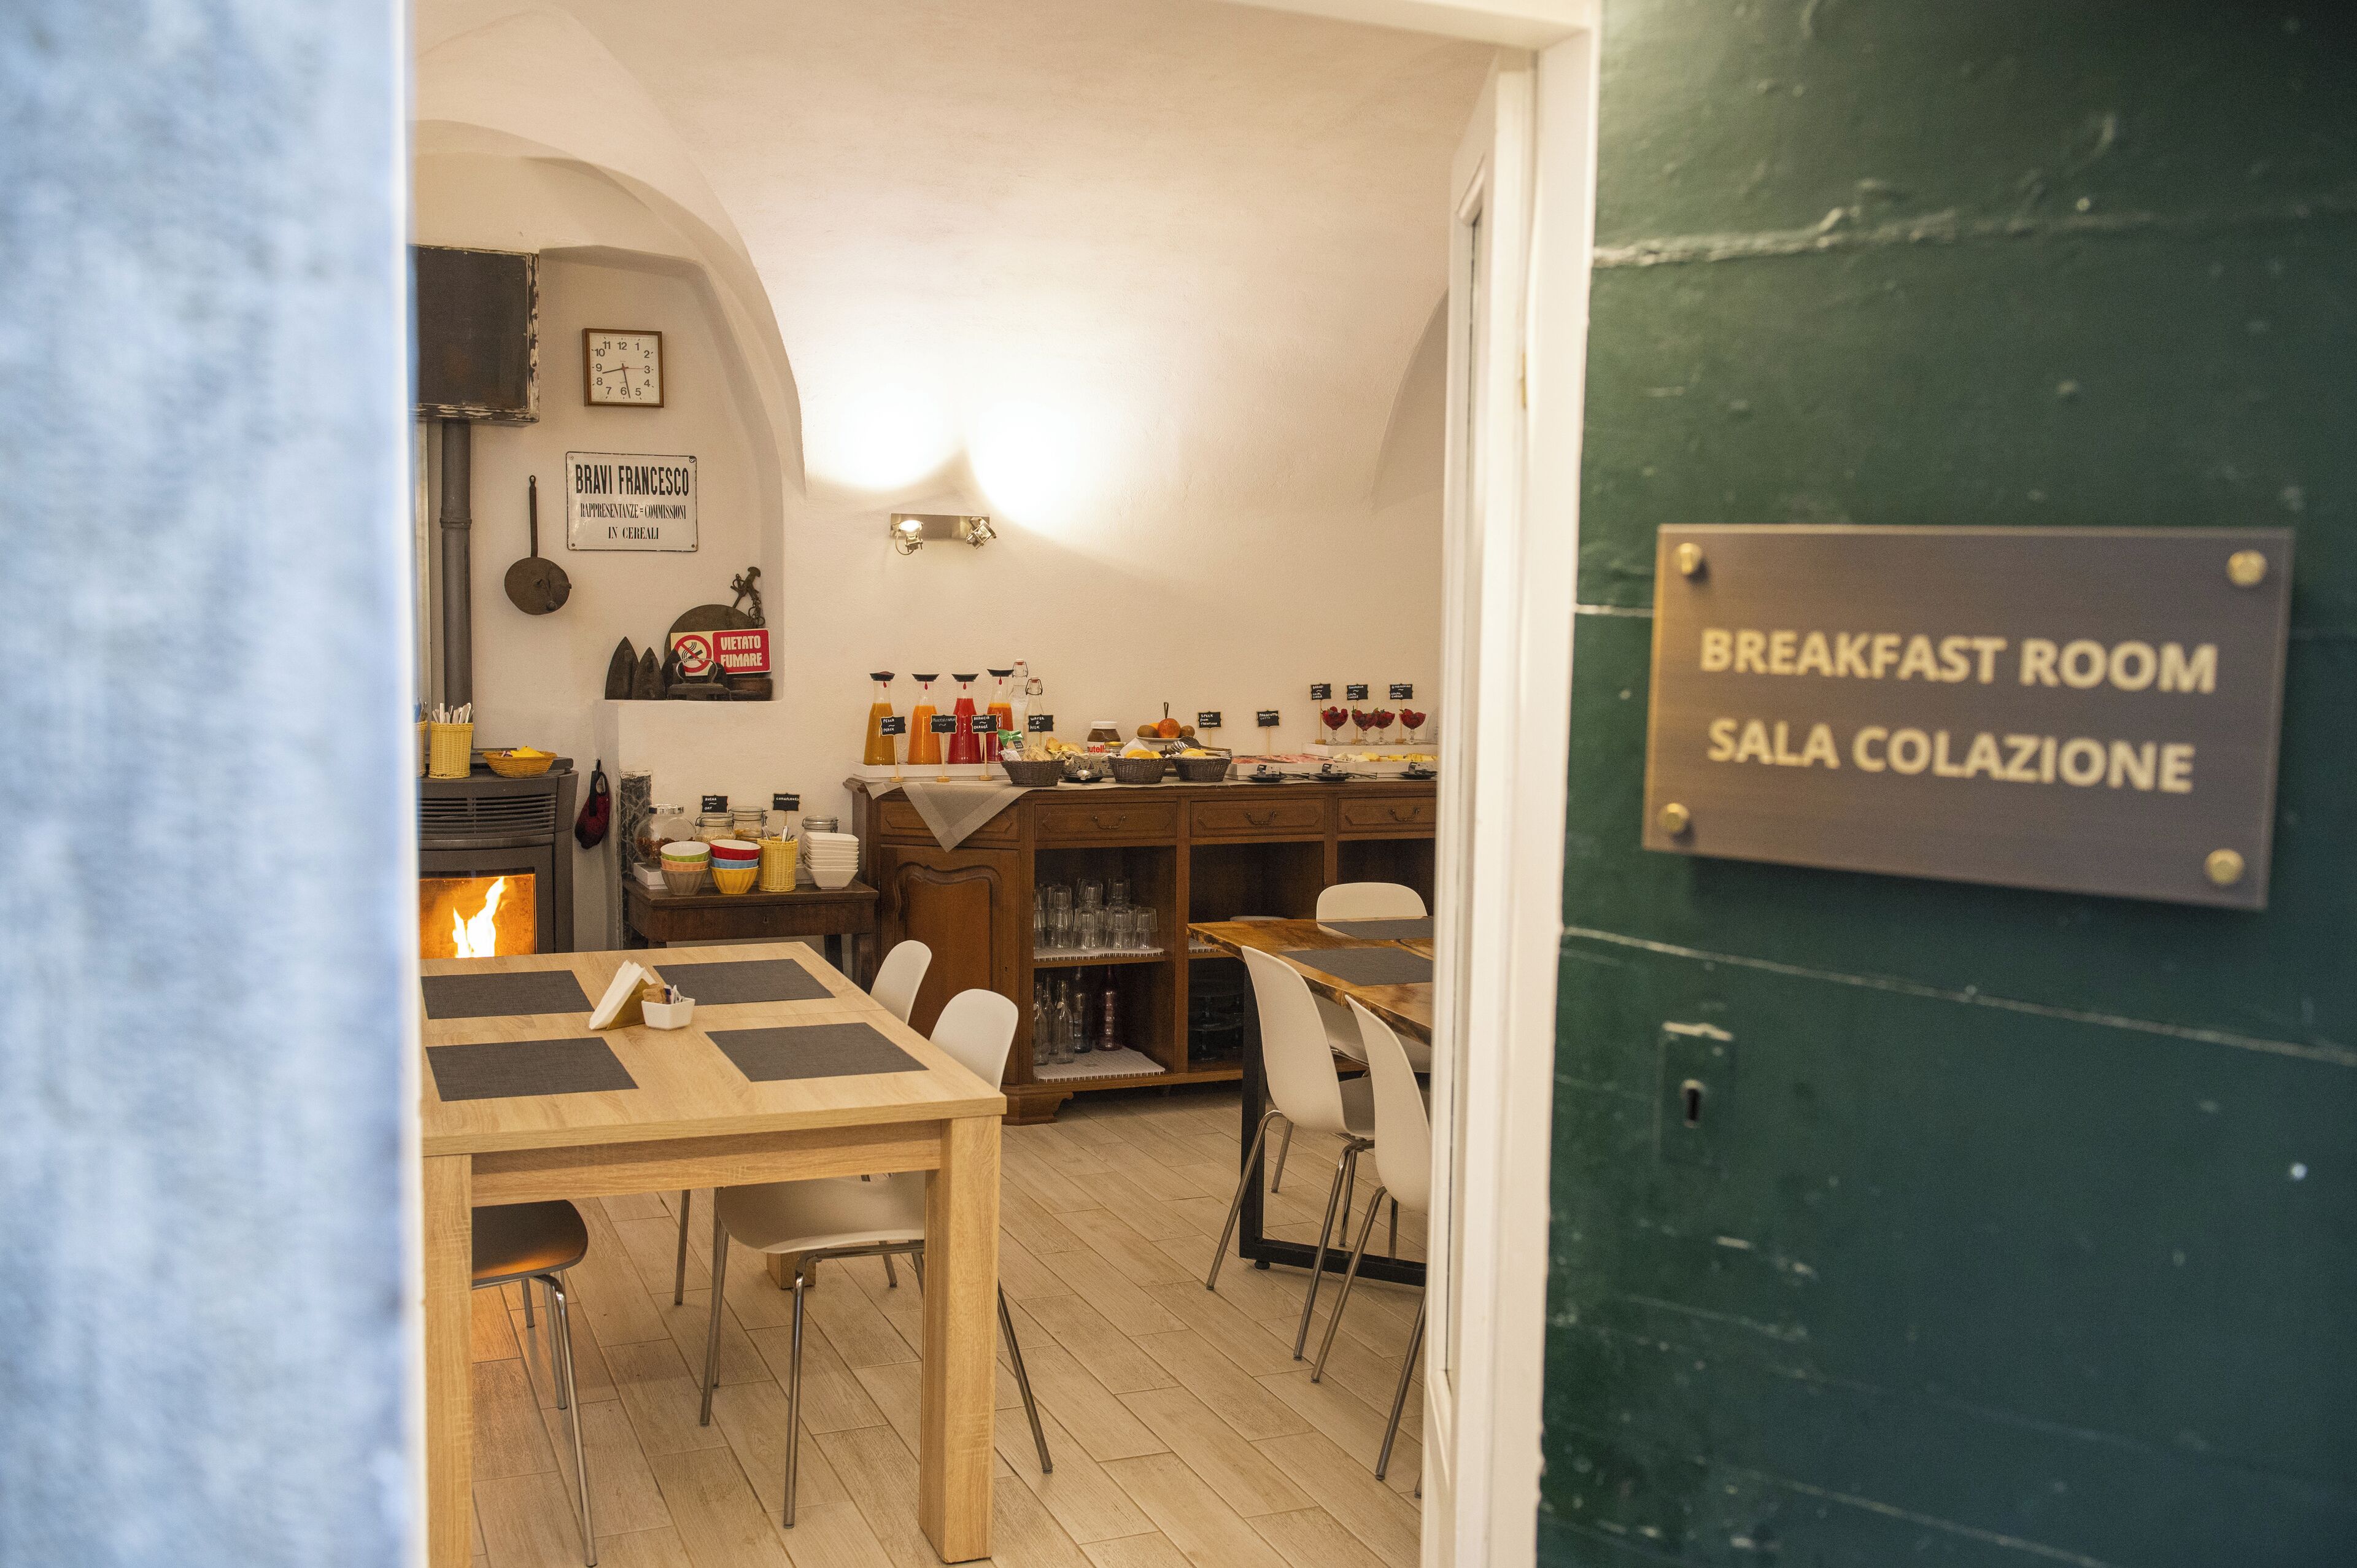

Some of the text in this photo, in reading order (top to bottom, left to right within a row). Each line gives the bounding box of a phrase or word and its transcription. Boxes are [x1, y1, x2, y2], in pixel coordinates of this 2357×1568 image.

[595, 348, 605, 357] 10
[644, 350, 650, 358] 2
[595, 363, 602, 372] 9
[644, 365, 651, 374] 3
[620, 387, 627, 395] 6
[575, 464, 689, 496] BRAVI FRANCESCO
[580, 503, 639, 519] RAPPRESENTANZE
[644, 504, 686, 519] COMMISSIONI
[608, 527, 659, 539] IN CEREALI
[720, 635, 761, 651] VIETATO
[720, 652, 762, 668] FUMARE
[1700, 628, 2219, 695] BREAKFAST ROOM
[1707, 718, 2196, 794] SALA COLAZIONE
